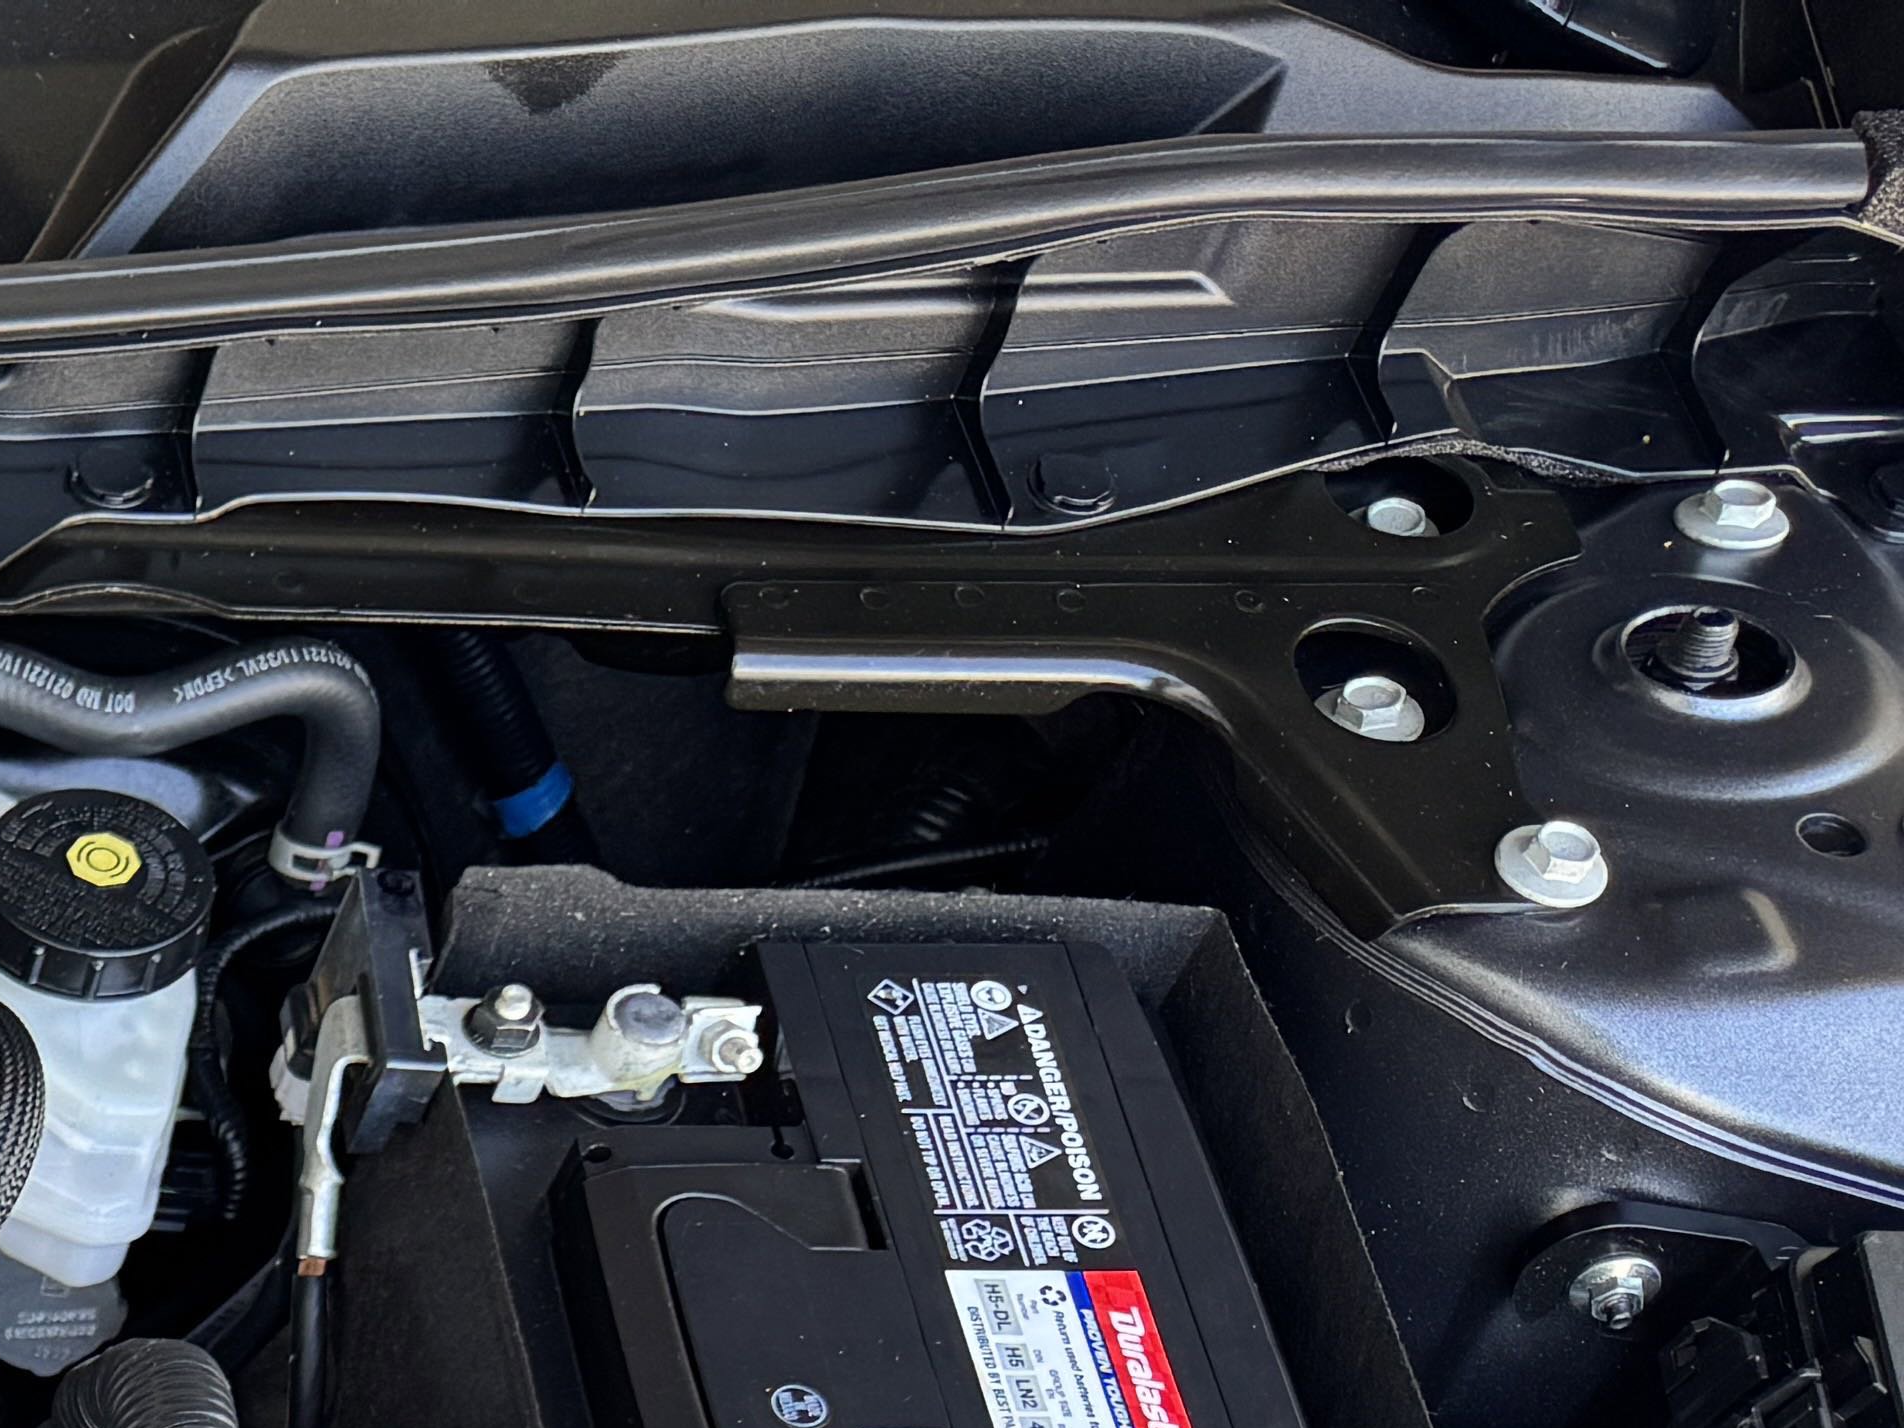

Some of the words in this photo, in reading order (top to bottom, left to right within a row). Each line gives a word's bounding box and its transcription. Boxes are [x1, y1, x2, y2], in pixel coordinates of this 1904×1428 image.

[104, 691, 136, 714] DOT
[1023, 1023, 1103, 1201] DANGER/POISON
[965, 1306, 997, 1368] DISTRIBUTED
[986, 1372, 1002, 1384] BY
[983, 1284, 1014, 1331] H5-DL
[1003, 1347, 1025, 1367] H5
[1014, 1379, 1039, 1408] LN2
[1051, 1311, 1074, 1343] Return
[1078, 1308, 1113, 1372] PROVEN
[1064, 1347, 1083, 1371] used
[1072, 1374, 1098, 1417] batteries
